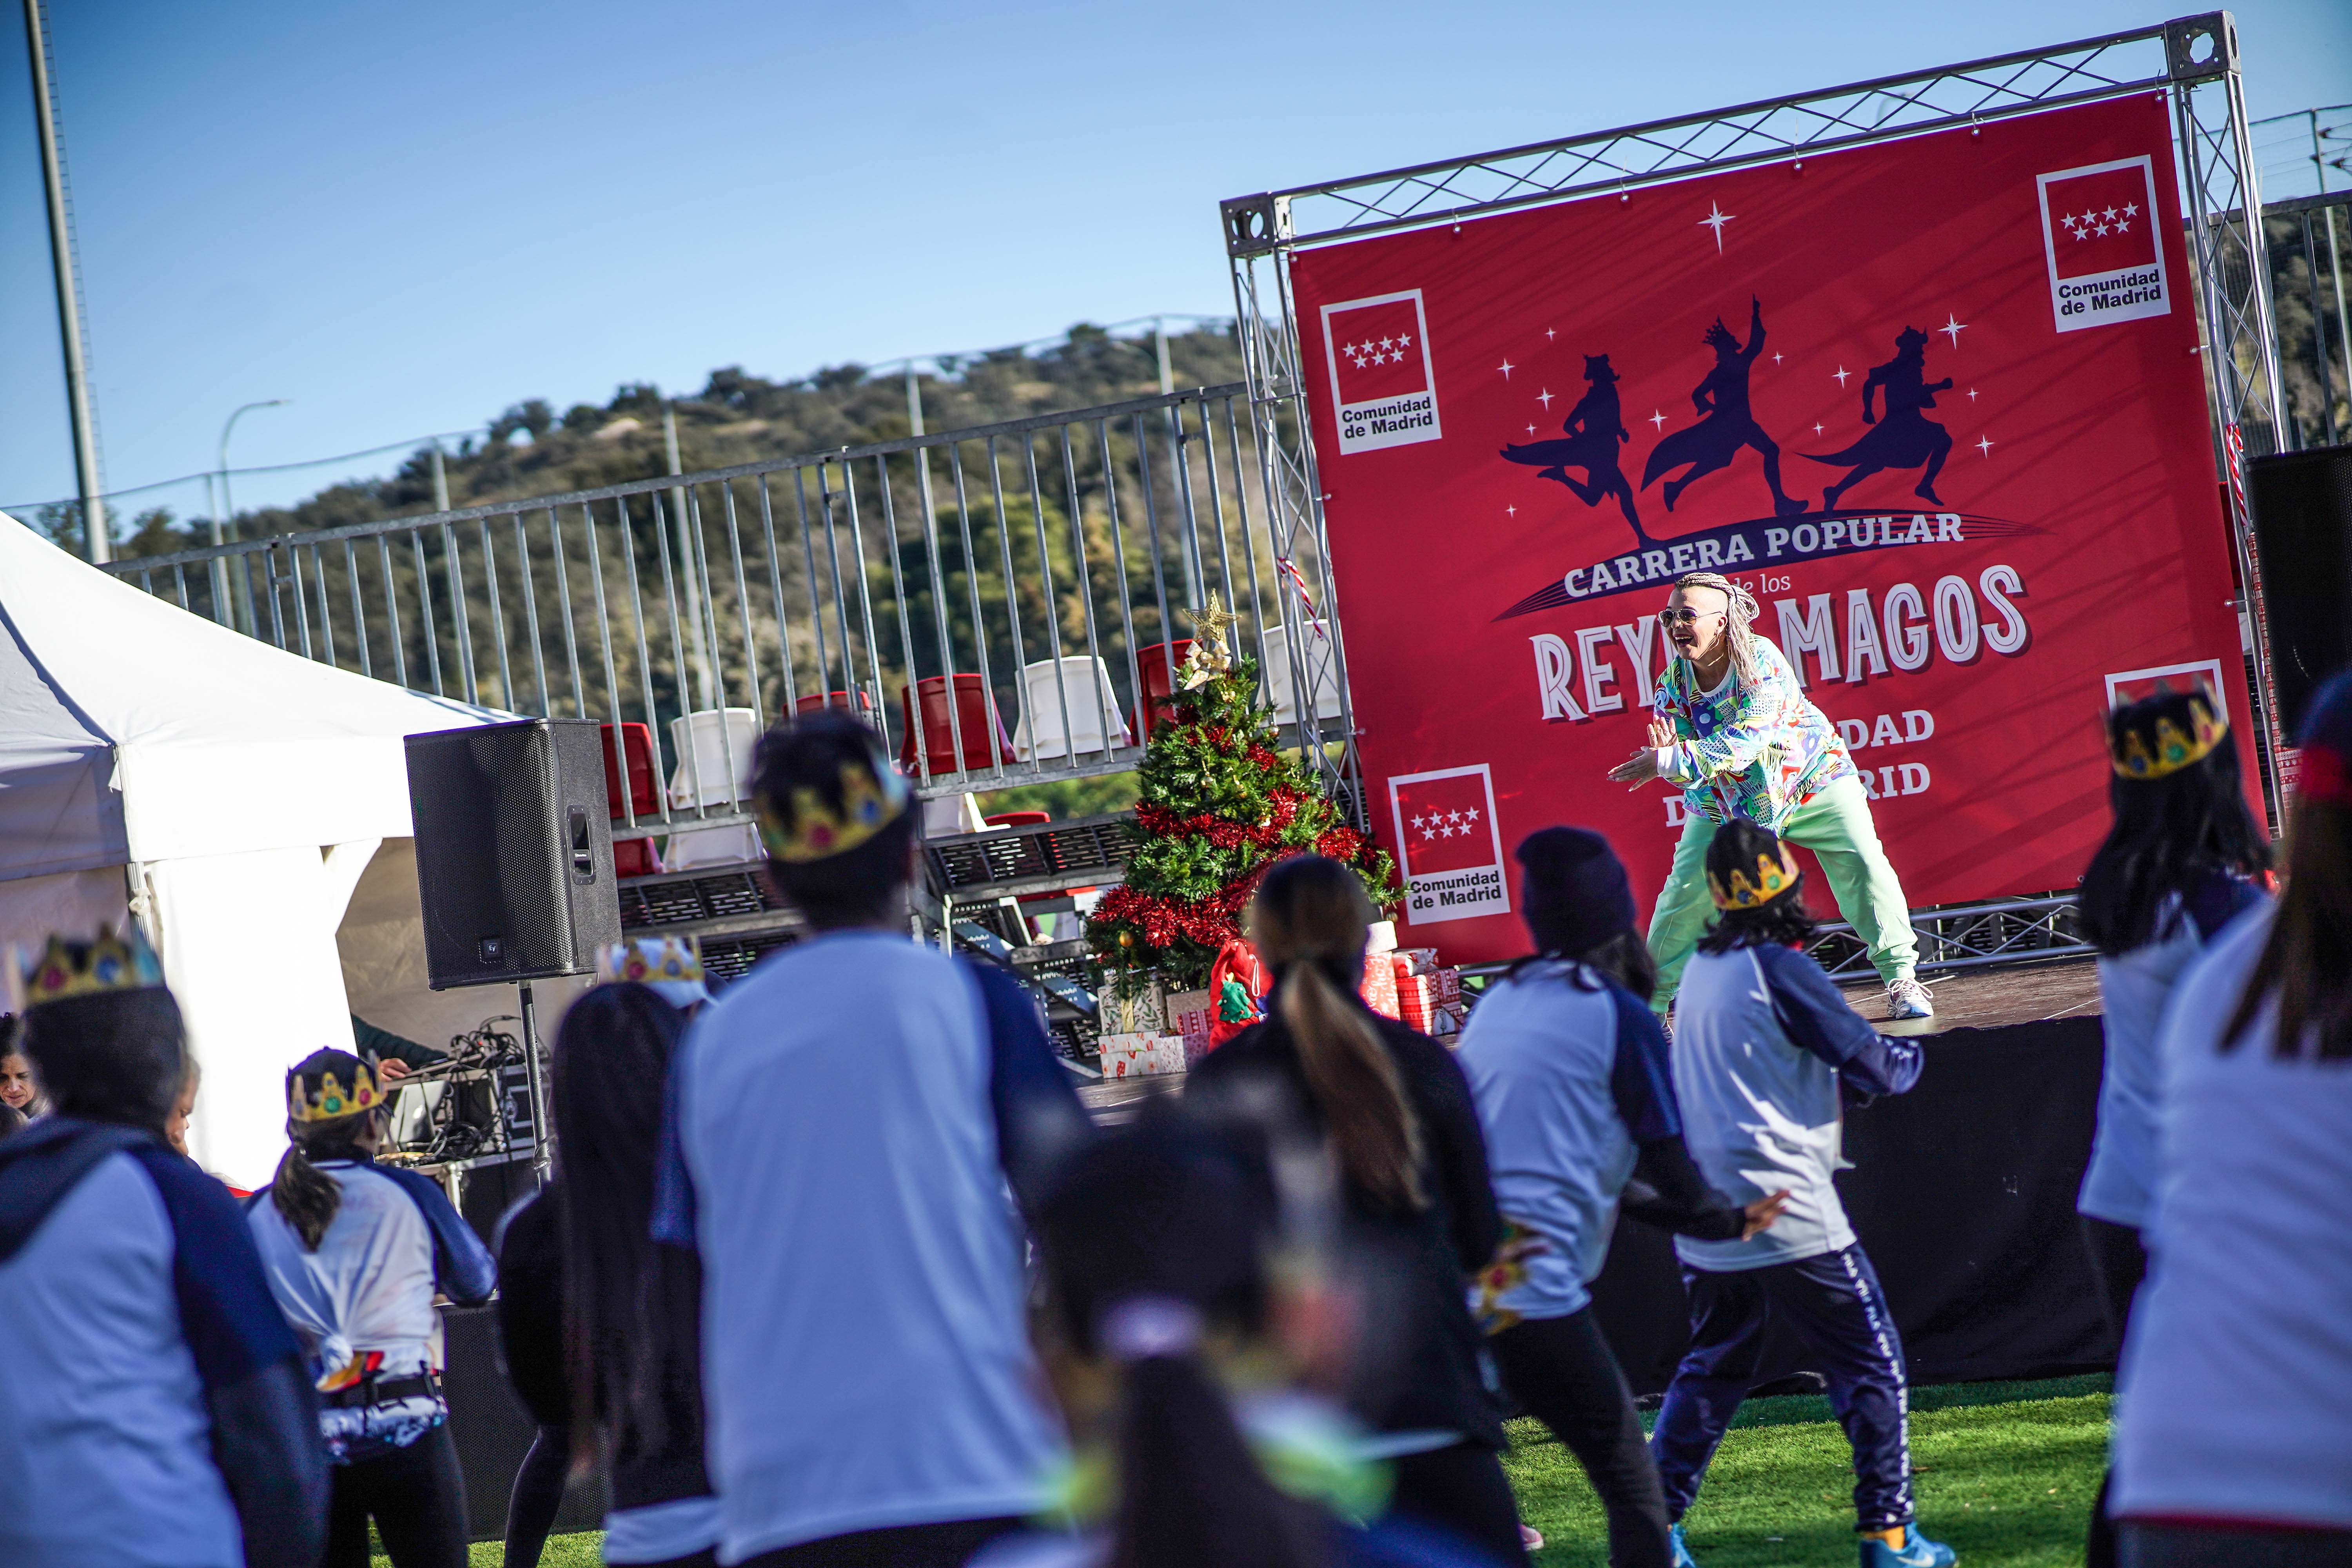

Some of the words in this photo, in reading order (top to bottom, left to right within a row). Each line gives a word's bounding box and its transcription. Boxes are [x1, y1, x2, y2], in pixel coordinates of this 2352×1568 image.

[2058, 269, 2160, 298] Comunidad
[2060, 301, 2085, 315] de
[2092, 285, 2161, 310] Madrid
[1342, 397, 1431, 423] Comunidad
[1344, 425, 1365, 439] de
[1371, 412, 1433, 434] Madrid
[1564, 534, 1755, 597] CARRERA
[1764, 514, 1964, 557] POPULAR
[1760, 573, 1791, 593] los
[1529, 615, 1679, 721] REY
[1773, 564, 2027, 688] MAGOS
[1411, 871, 1499, 893] Comunidad
[1412, 896, 1434, 910] de
[1440, 886, 1501, 906] Madrid
